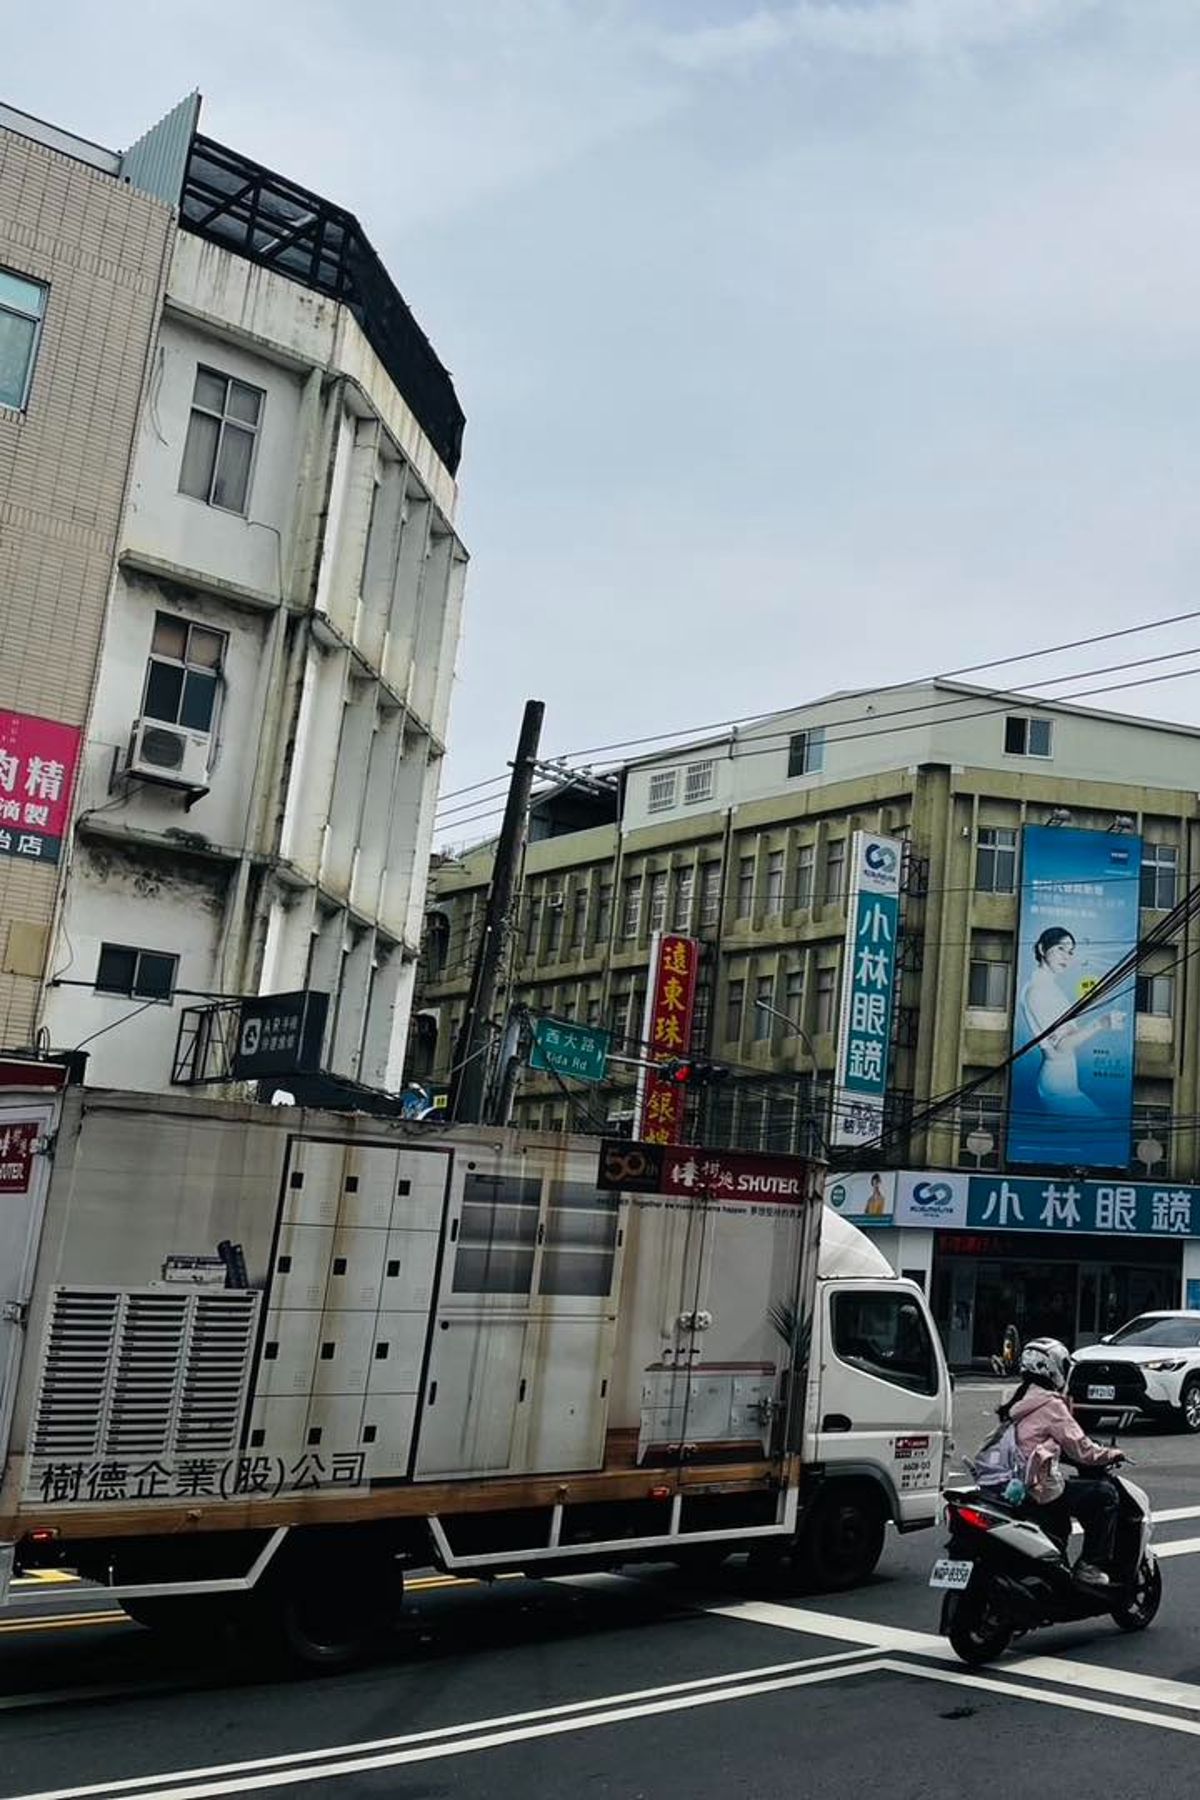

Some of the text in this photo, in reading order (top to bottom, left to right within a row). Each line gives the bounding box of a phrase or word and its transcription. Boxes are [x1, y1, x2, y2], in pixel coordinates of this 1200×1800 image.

[849, 902, 892, 1081] 小林眼鏡
[546, 1027, 594, 1052] 西大路
[645, 941, 689, 1145] 遠東珠銀
[738, 1174, 799, 1194] SHUTER
[982, 1182, 1191, 1233] 小林眼鏡
[40, 1451, 366, 1503] 樹德企業(股)公司
